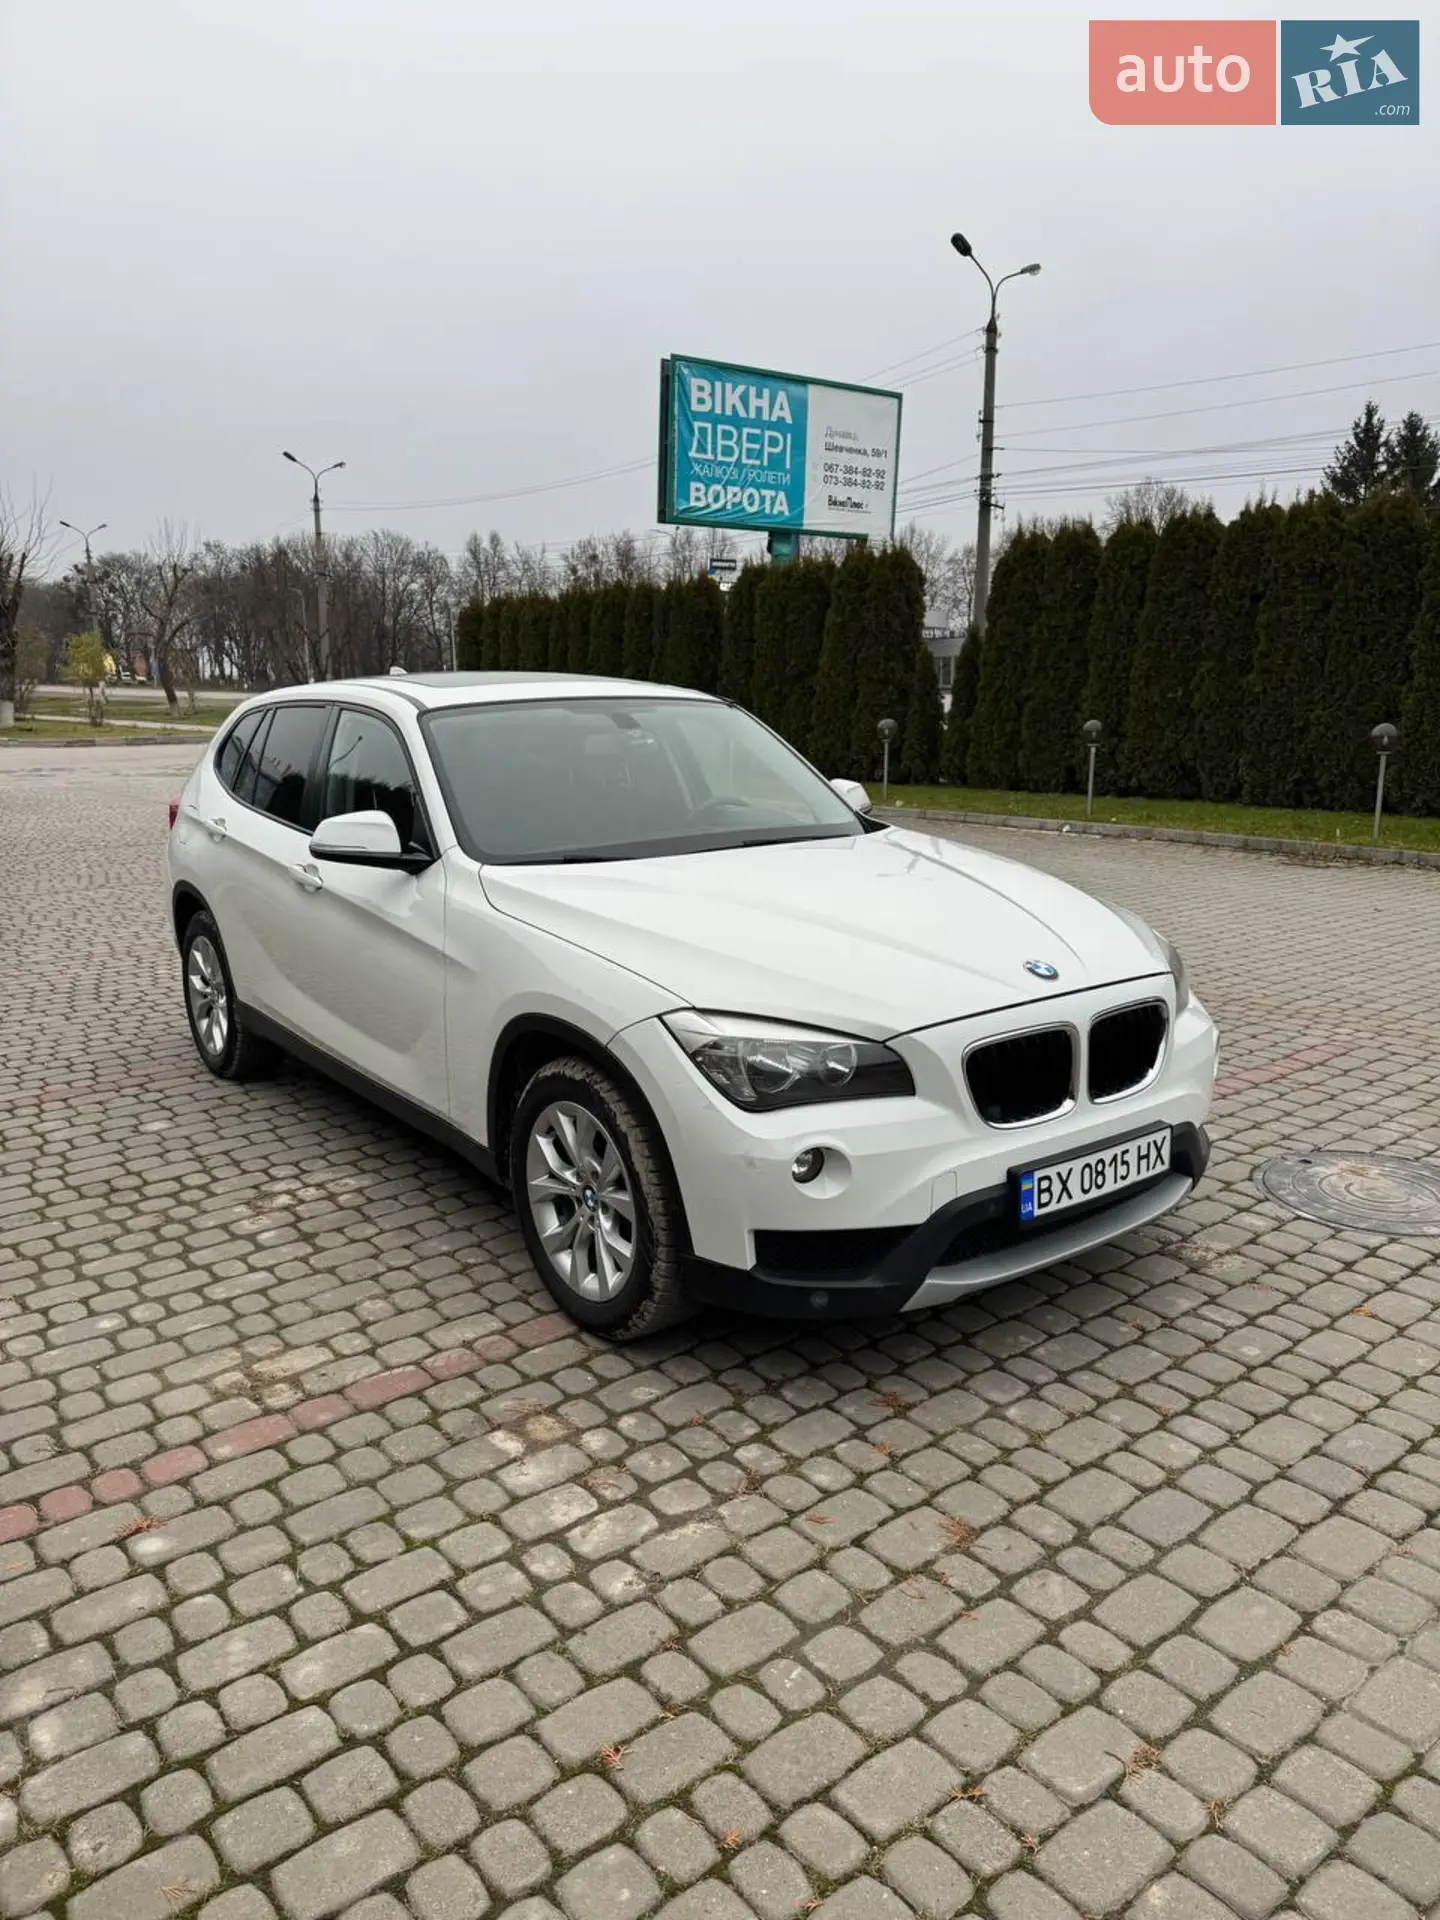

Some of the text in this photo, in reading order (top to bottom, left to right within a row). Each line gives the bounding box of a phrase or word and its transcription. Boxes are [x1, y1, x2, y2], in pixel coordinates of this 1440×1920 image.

[690, 376, 793, 425] ВІКНА
[688, 420, 792, 469] ДВЕРІ
[823, 462, 886, 480] 067-384-82-92
[823, 474, 885, 491] 073-384-82-92
[690, 481, 790, 517] ВОРОТА
[1037, 1135, 1167, 1210] BX 0815 HX
